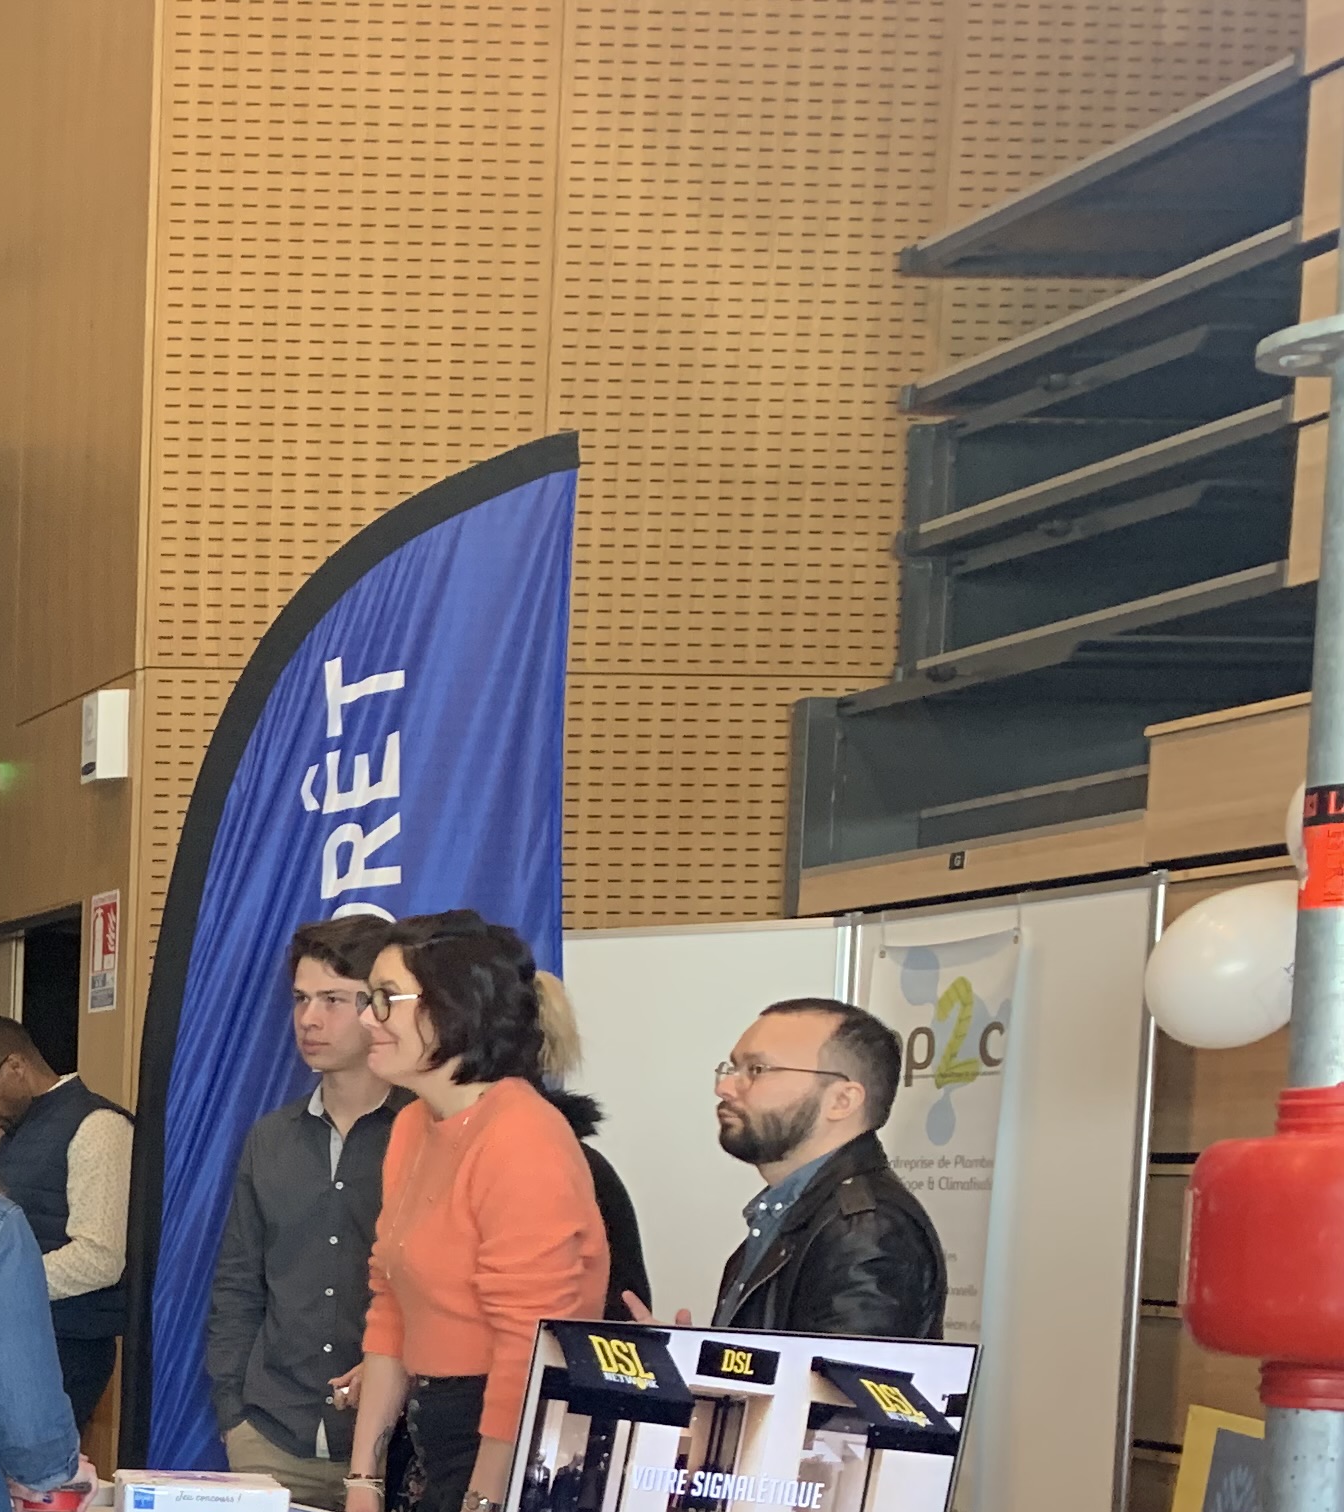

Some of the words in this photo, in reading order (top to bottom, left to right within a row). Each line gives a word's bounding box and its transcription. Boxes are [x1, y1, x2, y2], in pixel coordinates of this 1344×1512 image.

[300, 656, 406, 922] RÊT
[588, 1335, 656, 1380] DSL
[720, 1349, 755, 1376] DSL
[858, 1378, 927, 1418] DSL
[633, 1465, 689, 1496] VOTRE
[690, 1470, 826, 1510] SIGNALÉTIQUE
